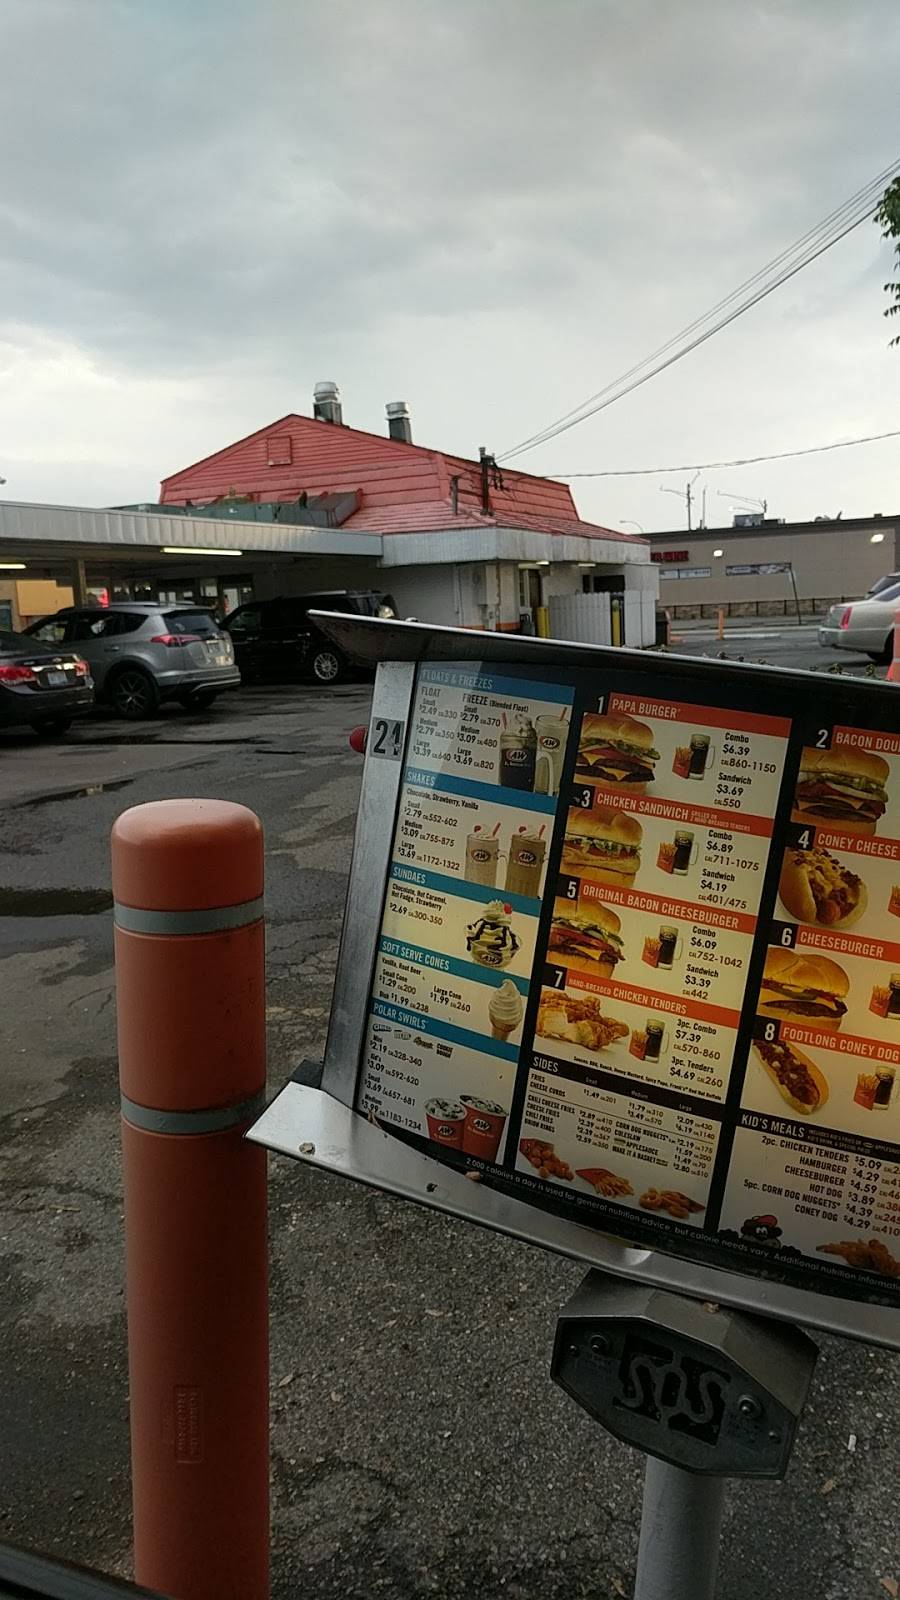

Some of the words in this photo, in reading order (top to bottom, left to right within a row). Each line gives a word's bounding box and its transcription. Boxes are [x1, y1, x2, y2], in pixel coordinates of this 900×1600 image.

[459, 675, 493, 689] FREEZES
[421, 687, 440, 697] FLOAT
[463, 693, 488, 705] FREEZE
[598, 695, 604, 714] 1
[612, 698, 636, 713] PAPA
[419, 705, 437, 715] $2.49
[464, 705, 477, 713] Small
[460, 712, 479, 723] $2.79
[416, 724, 434, 736] $2.79
[461, 725, 479, 734] Medium
[457, 732, 476, 743] $3.09
[725, 732, 749, 743] Combo
[816, 729, 829, 748] 2
[836, 732, 873, 748] BACON
[876, 738, 900, 753] DOU
[413, 746, 431, 757] $3.39
[458, 747, 471, 756] Large
[722, 744, 750, 756] $6.39
[454, 754, 472, 766] $3.69
[407, 770, 435, 786] SHAKES
[719, 772, 752, 785] Sandwich
[716, 784, 744, 796] $3.69
[581, 790, 590, 808] 3
[597, 793, 637, 811] CHICKEN
[639, 801, 689, 820] SANDWICH
[405, 807, 422, 817] $2.79
[405, 820, 422, 829] Medium
[401, 826, 419, 838] $3.09
[708, 829, 732, 841] Combo
[401, 841, 414, 850] Large
[706, 841, 733, 853] $6.89
[798, 830, 810, 849] 4
[818, 833, 854, 850] CONEY
[856, 840, 898, 858] CHEESE
[398, 847, 415, 859] $3.69
[393, 866, 426, 884] SUNDAES
[702, 868, 735, 882] Sandwich
[700, 879, 727, 892] $4.19
[390, 903, 407, 914] $2.69
[567, 880, 576, 898] 5
[583, 885, 625, 904] ORIGINAL
[627, 895, 659, 911] BACON
[661, 902, 739, 928] CHEESEBURGER
[692, 925, 716, 937] Combo
[690, 936, 717, 950] $6.09
[781, 928, 792, 946] 6
[800, 931, 884, 958] CHEESEBURGER
[382, 941, 400, 954] SOFT
[400, 947, 423, 962] SERVE
[425, 954, 449, 970] CONES
[686, 964, 719, 978] Sandwich
[379, 975, 396, 987] $1.29
[685, 974, 711, 988] $3.39
[434, 986, 447, 995] Large
[554, 970, 564, 987] 7
[612, 987, 648, 1003] CHICKEN
[650, 996, 687, 1015] TENDERS
[391, 993, 409, 1005] $1.99
[430, 992, 449, 1005] $1.99
[373, 1002, 397, 1018] POLAR
[398, 1011, 426, 1029] SWIRLS
[693, 1022, 717, 1035] Combo
[675, 1029, 701, 1043] $7.39
[765, 1023, 775, 1040] 8
[783, 1027, 837, 1048] FOOTLONG
[840, 1039, 876, 1056] CONEY
[877, 1048, 900, 1061] DOG
[370, 1040, 387, 1053] $2.19
[368, 1059, 384, 1072] $3.09
[533, 1056, 558, 1073] SIDES
[687, 1060, 714, 1074] Tenders
[531, 1074, 545, 1083] FRIES
[670, 1067, 695, 1080] $4.69
[365, 1079, 382, 1093] $3.69
[530, 1081, 548, 1092] CHEESE
[741, 1114, 768, 1130] KID'S
[771, 1121, 805, 1138] MEALS
[780, 1140, 813, 1154] CHICKEN
[815, 1148, 850, 1163] TENDERS
[855, 1156, 881, 1170] $5.09
[799, 1156, 847, 1175] HAMBURGER
[852, 1168, 880, 1182] $4.29
[784, 1165, 845, 1186] CHEESEBURGER
[850, 1180, 877, 1193] $4.59
[762, 1184, 783, 1196] CORN
[785, 1190, 800, 1200] DOG
[846, 1203, 873, 1217] $4.39
[809, 1184, 824, 1193] HOT
[826, 1188, 843, 1198] DOG
[848, 1191, 875, 1206] $3.89
[795, 1204, 820, 1217] CONEY
[822, 1211, 838, 1222] DOG
[844, 1215, 870, 1229] $4.29
[522, 1179, 537, 1189] day
[545, 1186, 563, 1198] used
[564, 1191, 576, 1200] for
[577, 1197, 607, 1212] general
[609, 1207, 640, 1221] nutrition
[674, 1226, 688, 1236] but
[690, 1231, 719, 1243] calorie
[721, 1240, 748, 1252] needs
[773, 1253, 819, 1271] Additional
[822, 1263, 857, 1279] nutrition
